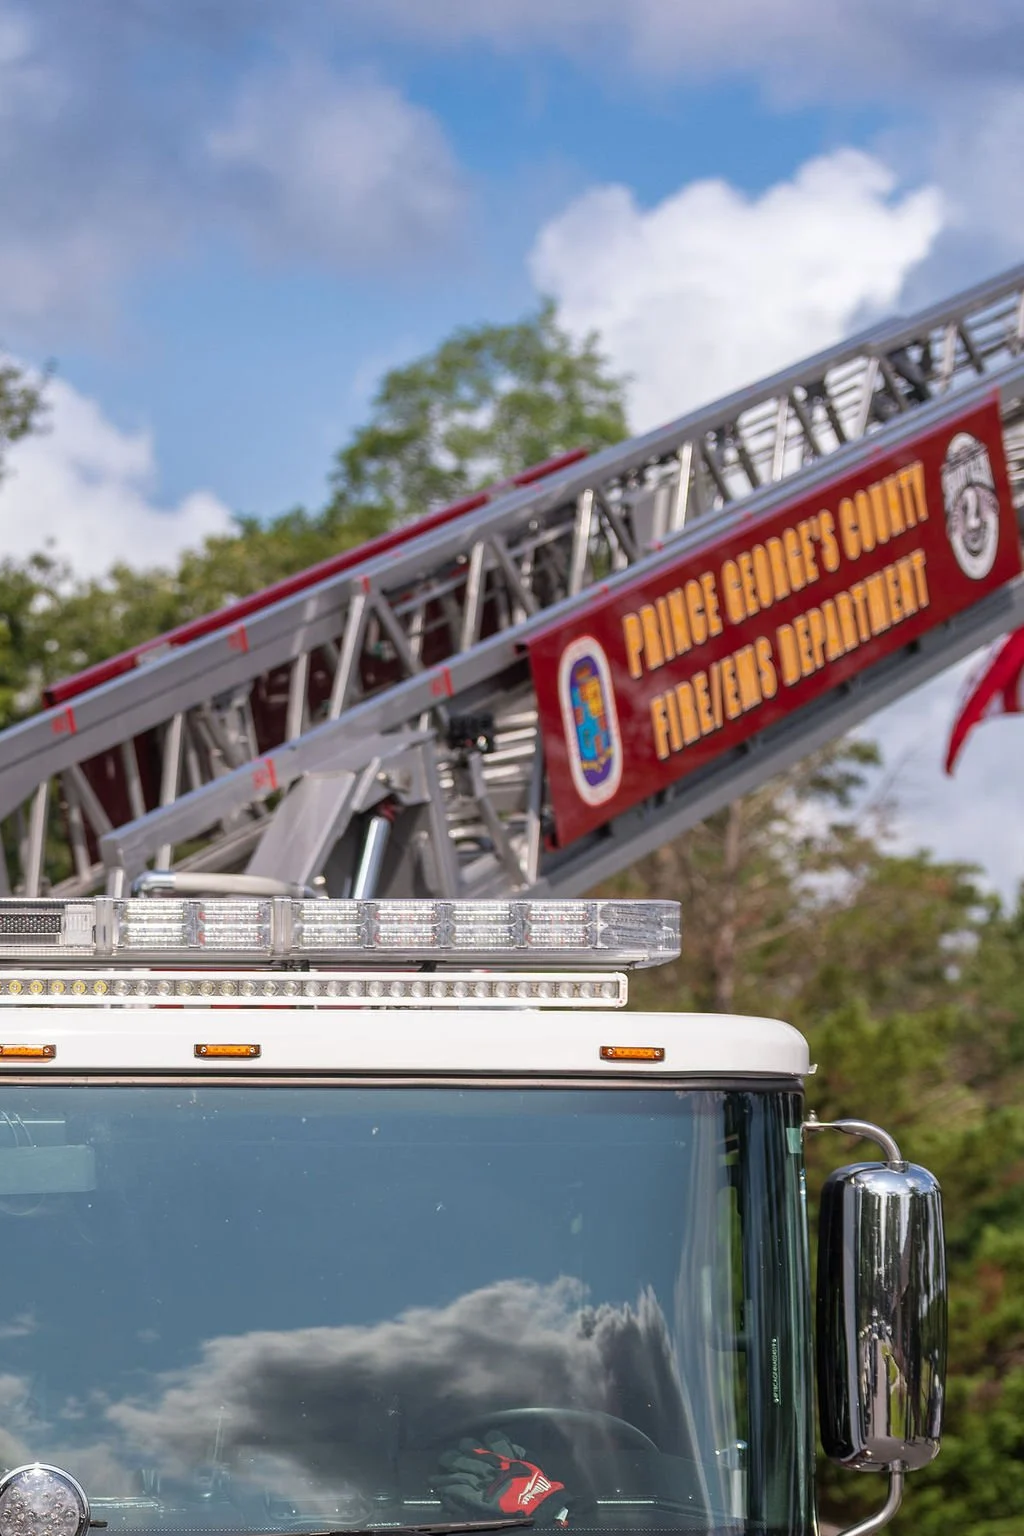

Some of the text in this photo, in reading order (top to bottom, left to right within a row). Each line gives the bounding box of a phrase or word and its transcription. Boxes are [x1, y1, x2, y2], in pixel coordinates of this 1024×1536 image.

[622, 460, 929, 681] PRINCE GEORGE'S COUNTY
[651, 548, 930, 760] FIRE/EMS DEPARTMENT
